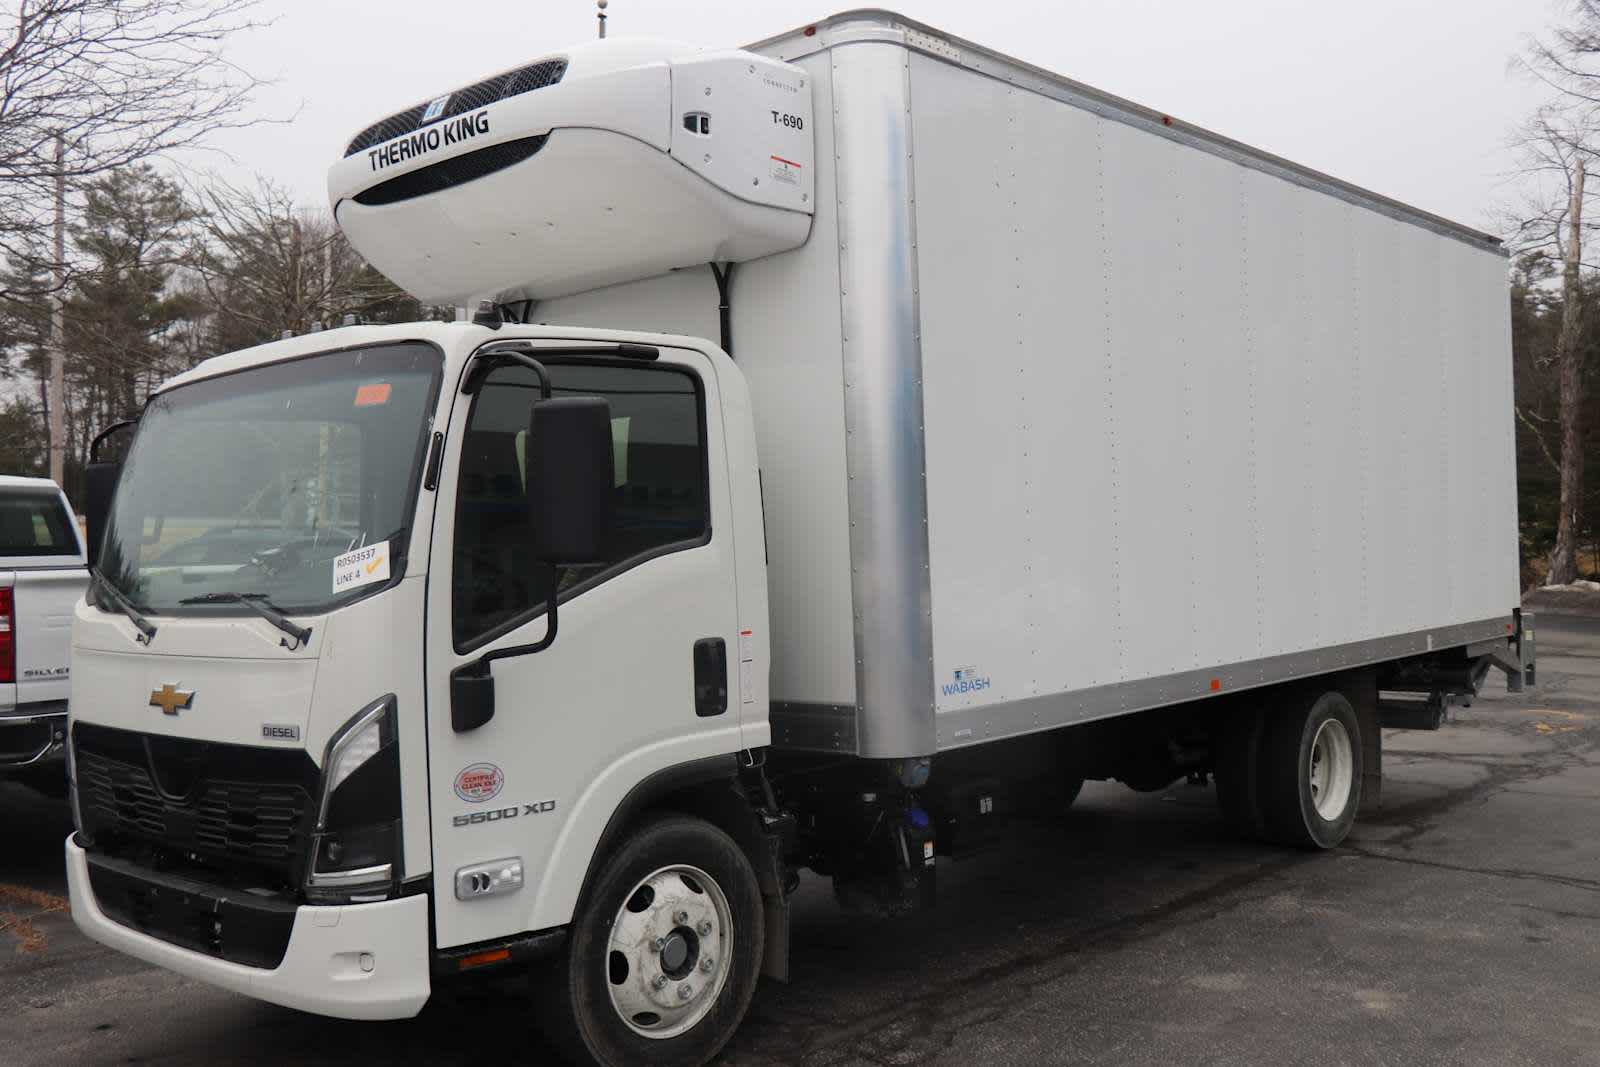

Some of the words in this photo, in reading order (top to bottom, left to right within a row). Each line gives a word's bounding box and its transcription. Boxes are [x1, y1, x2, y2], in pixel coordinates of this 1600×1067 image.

[771, 110, 803, 130] T-690
[368, 129, 440, 171] THERMO
[443, 110, 489, 146] KING
[336, 572, 353, 585] LINE
[942, 677, 991, 696] WABASH
[263, 726, 296, 738] DIESEL
[453, 807, 518, 827] 5500
[523, 800, 555, 816] XD
